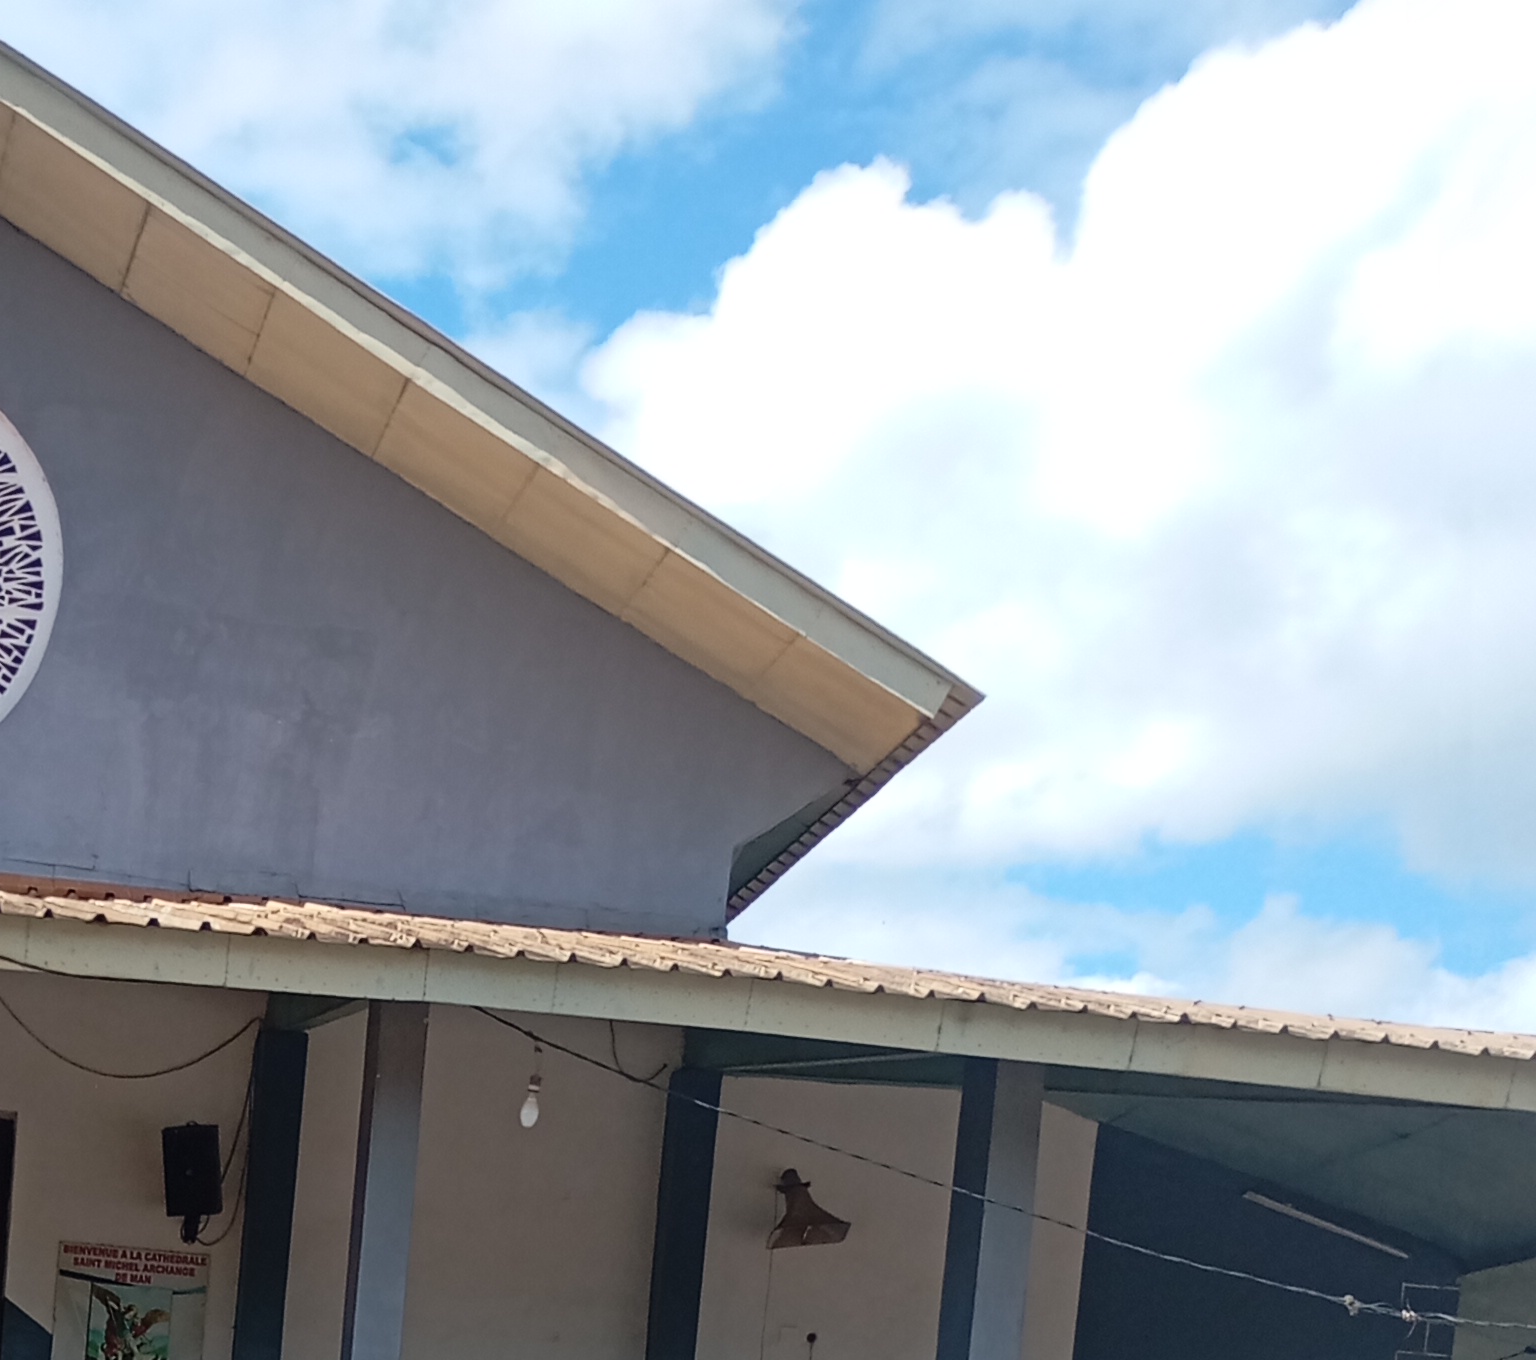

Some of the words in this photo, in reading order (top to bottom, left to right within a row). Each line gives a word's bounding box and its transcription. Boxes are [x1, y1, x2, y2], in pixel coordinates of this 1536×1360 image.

[63, 1244, 118, 1258] BIENVENUE
[120, 1249, 129, 1259] A
[130, 1250, 142, 1261] LA
[144, 1252, 207, 1266] CATHEDRALE
[73, 1257, 101, 1268] SAINT
[104, 1260, 139, 1272] MICHEL
[143, 1263, 195, 1277] ARCHANGE
[115, 1273, 128, 1283] DE
[130, 1274, 152, 1284] MAN
